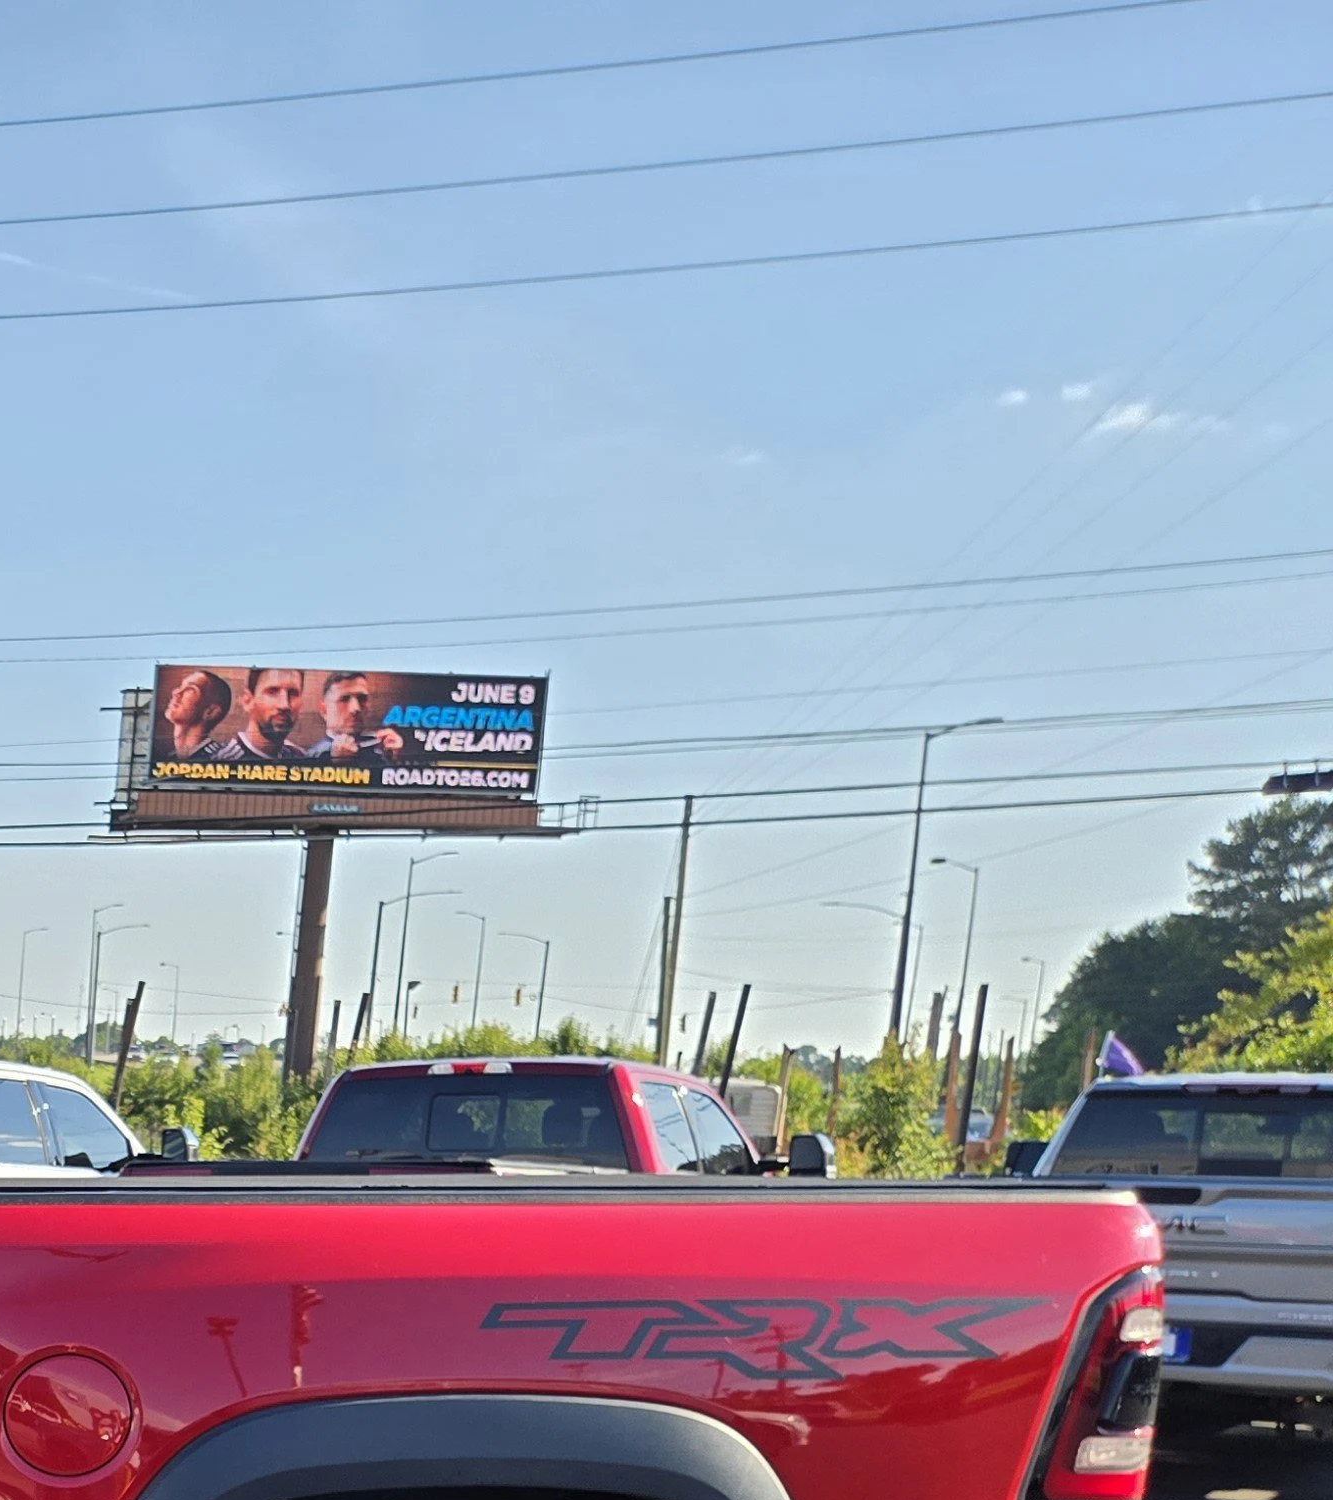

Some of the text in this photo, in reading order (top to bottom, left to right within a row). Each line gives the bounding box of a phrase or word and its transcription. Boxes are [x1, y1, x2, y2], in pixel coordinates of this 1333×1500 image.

[451, 682, 536, 705] JUNE 9
[382, 705, 534, 731] ARGENTINA
[424, 730, 533, 752] ICELAND
[152, 762, 371, 785] JORDAN-HARE STADIUM
[381, 768, 530, 789] ROADTO26.COM
[480, 1297, 1055, 1381] TRX
